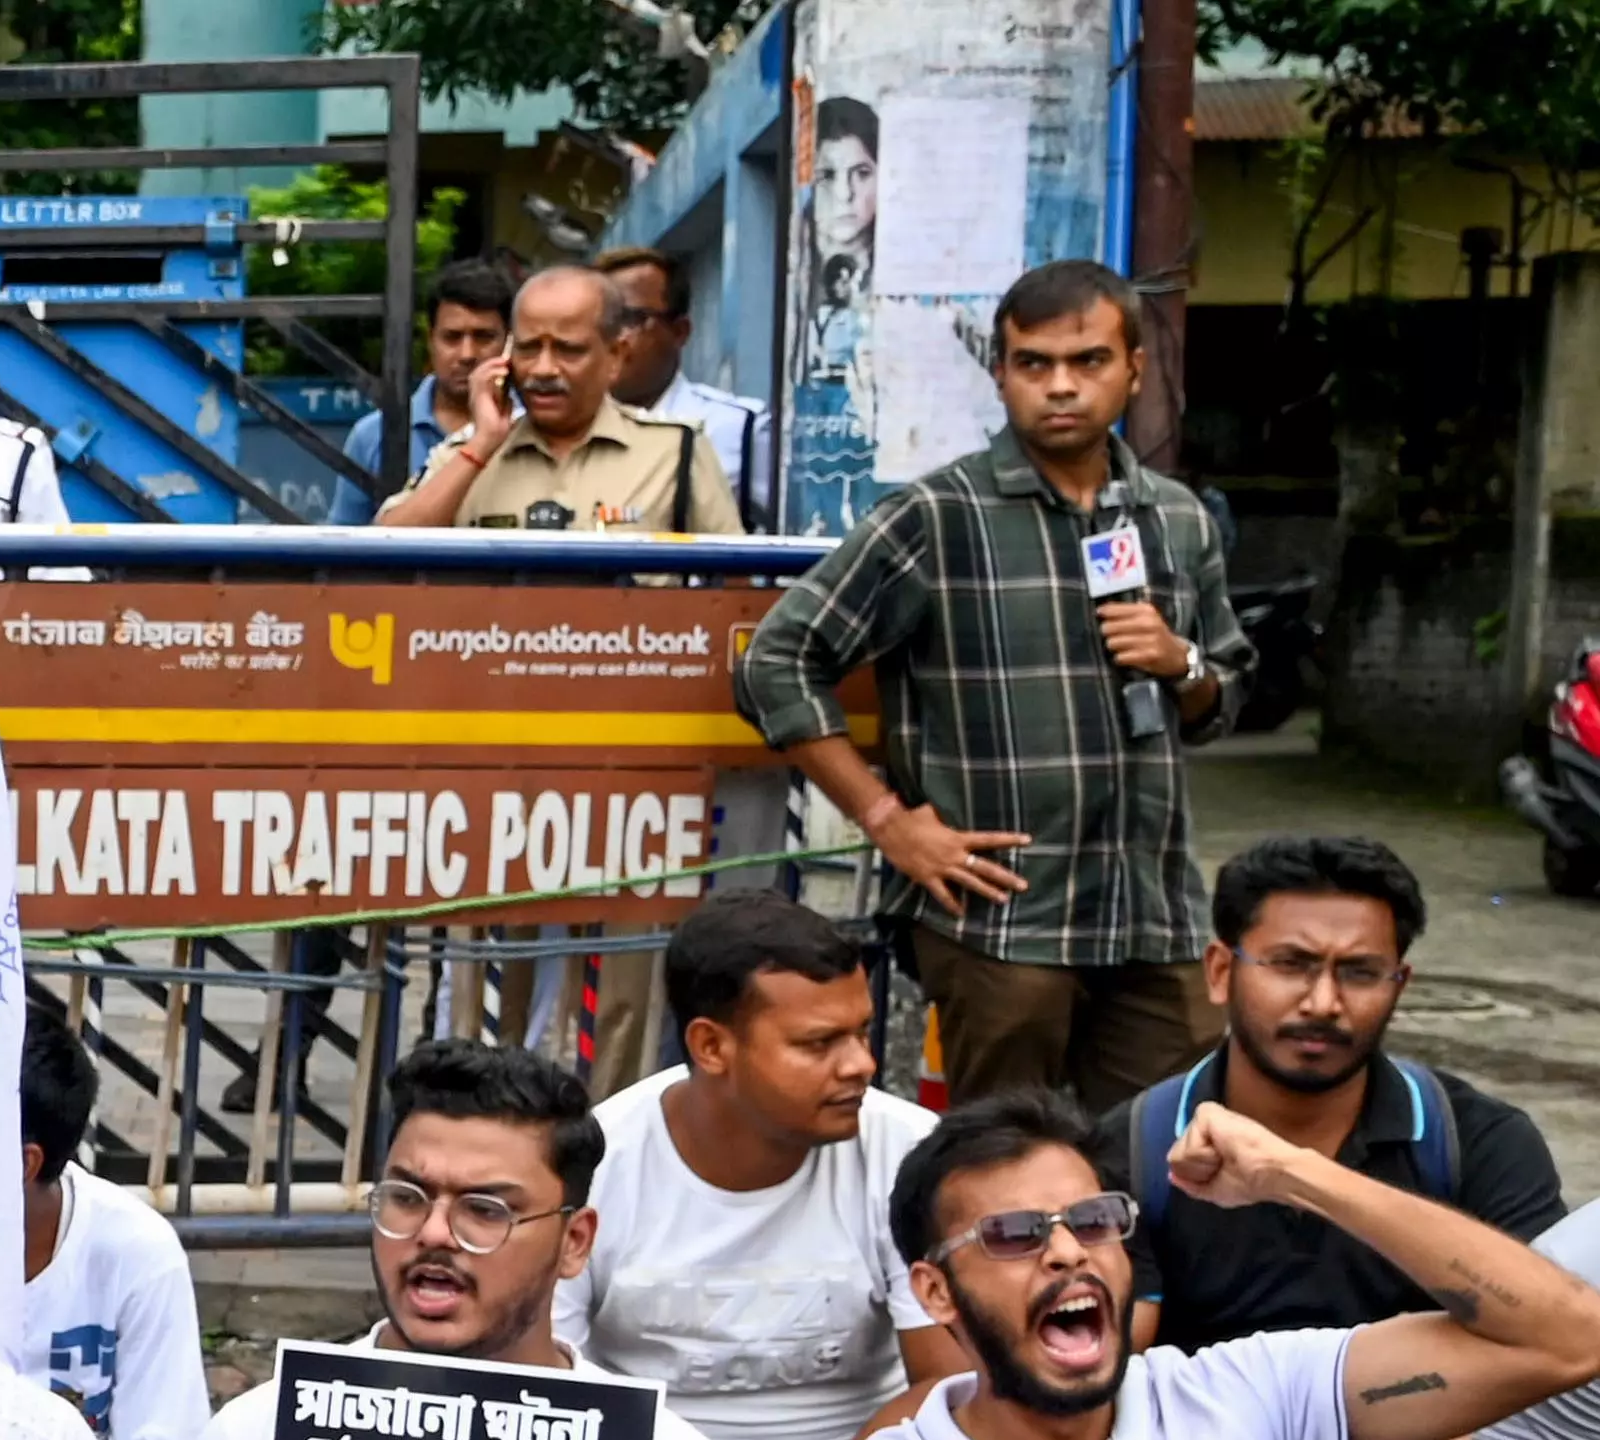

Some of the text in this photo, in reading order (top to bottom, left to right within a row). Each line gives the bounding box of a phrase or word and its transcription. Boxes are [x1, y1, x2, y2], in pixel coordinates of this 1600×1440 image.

[2, 202, 144, 223] LETTER BOX
[3, 608, 304, 651] पंजाब नैशनल बैंक
[409, 623, 710, 660] punjab national bank
[13, 789, 704, 900] LKATA TRAFFIC POLICE
